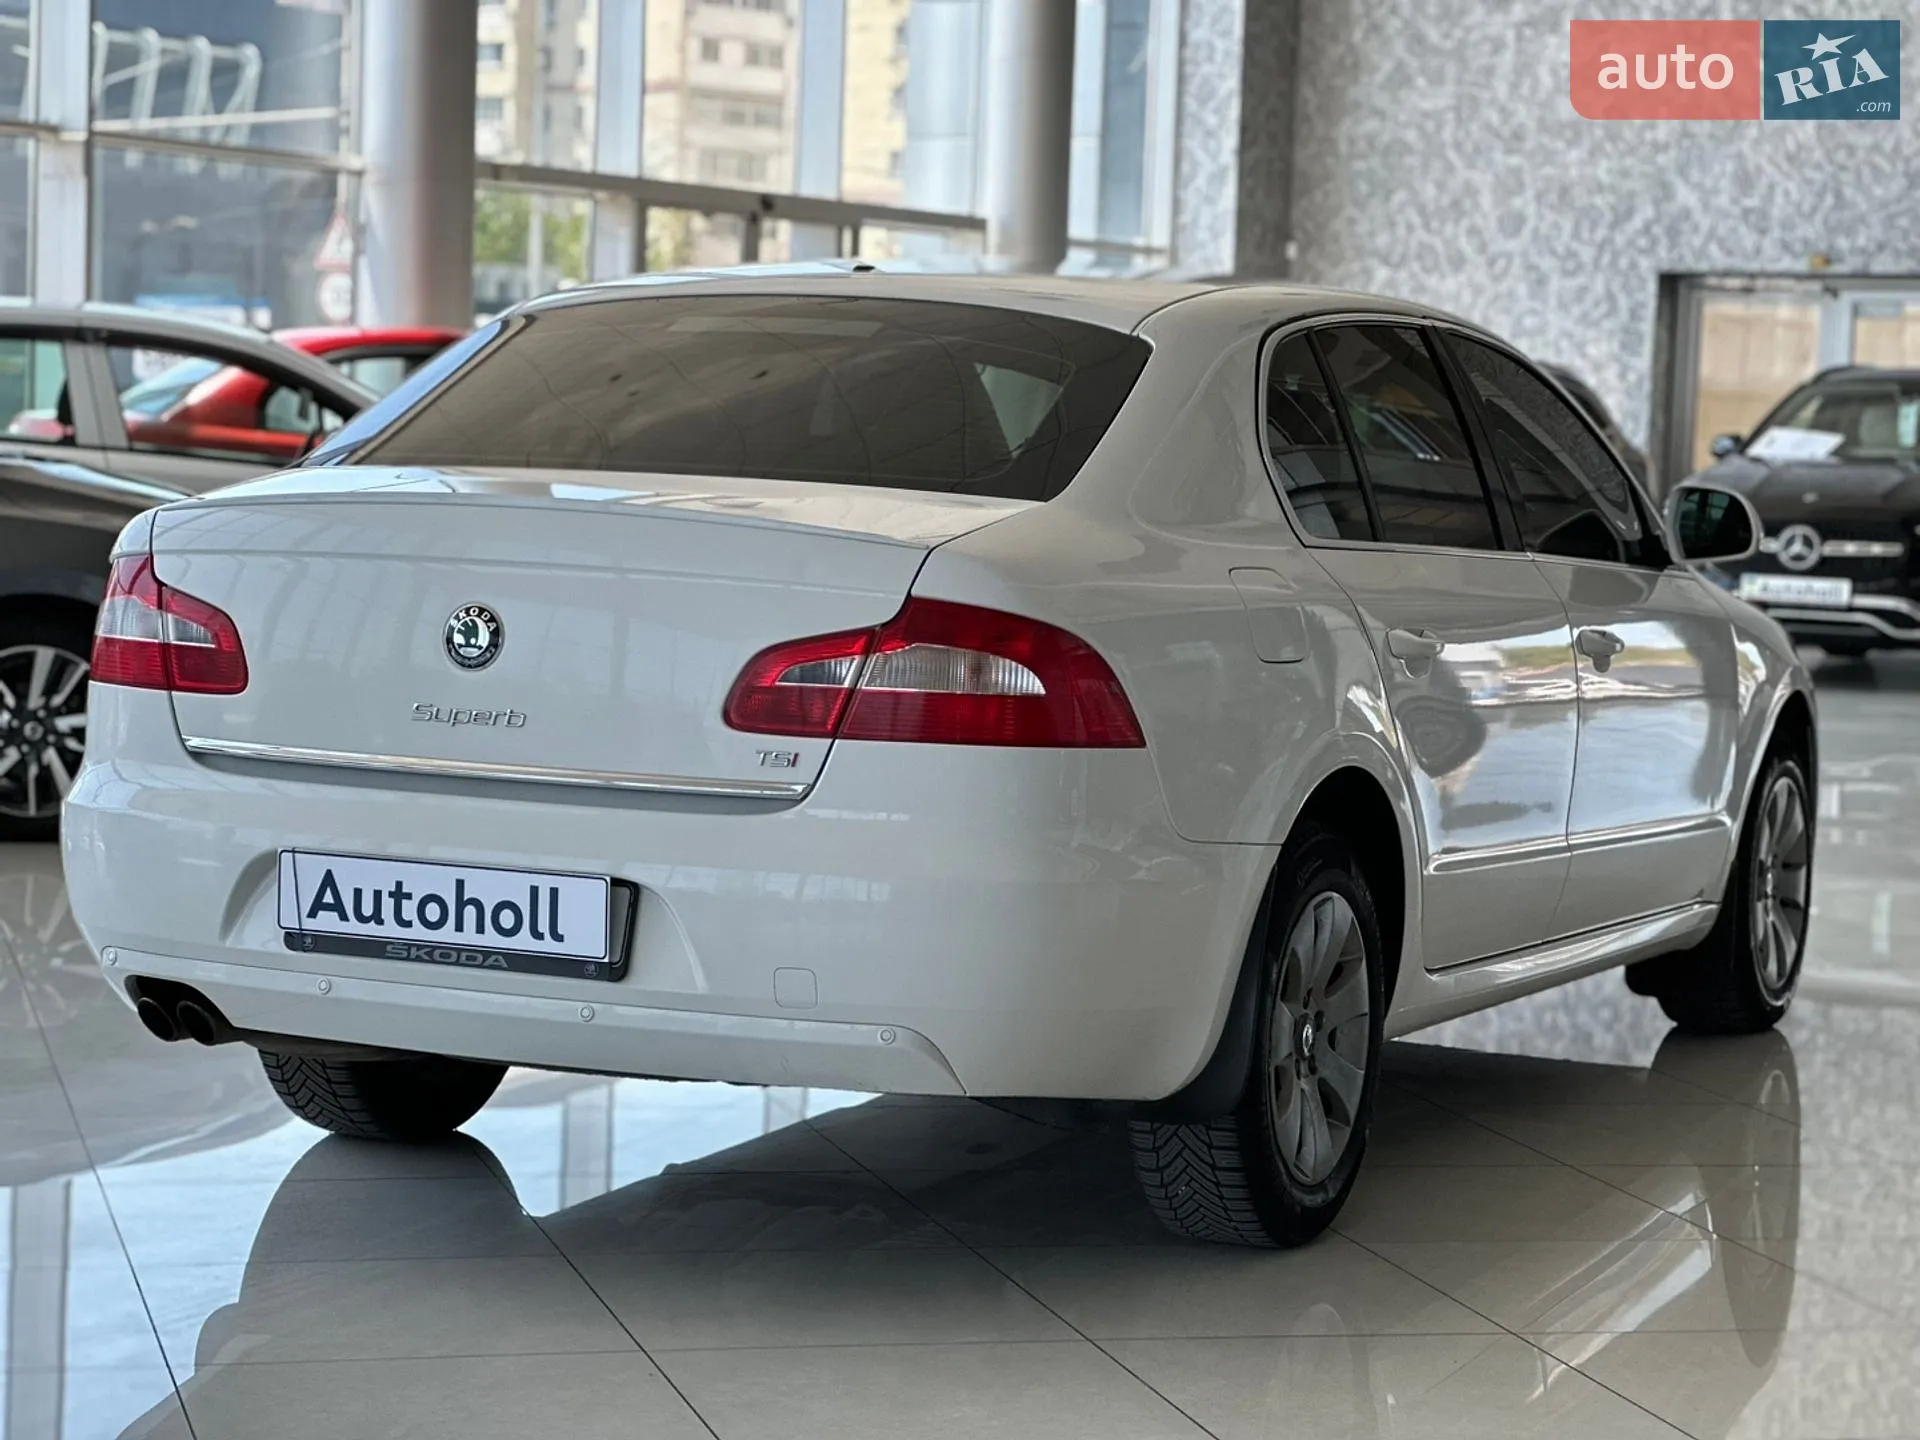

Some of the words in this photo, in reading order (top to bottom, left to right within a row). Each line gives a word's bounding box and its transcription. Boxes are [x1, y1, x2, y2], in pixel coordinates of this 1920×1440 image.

[411, 701, 527, 728] Superb
[756, 750, 800, 768] TSI
[305, 868, 565, 943] Autoholl
